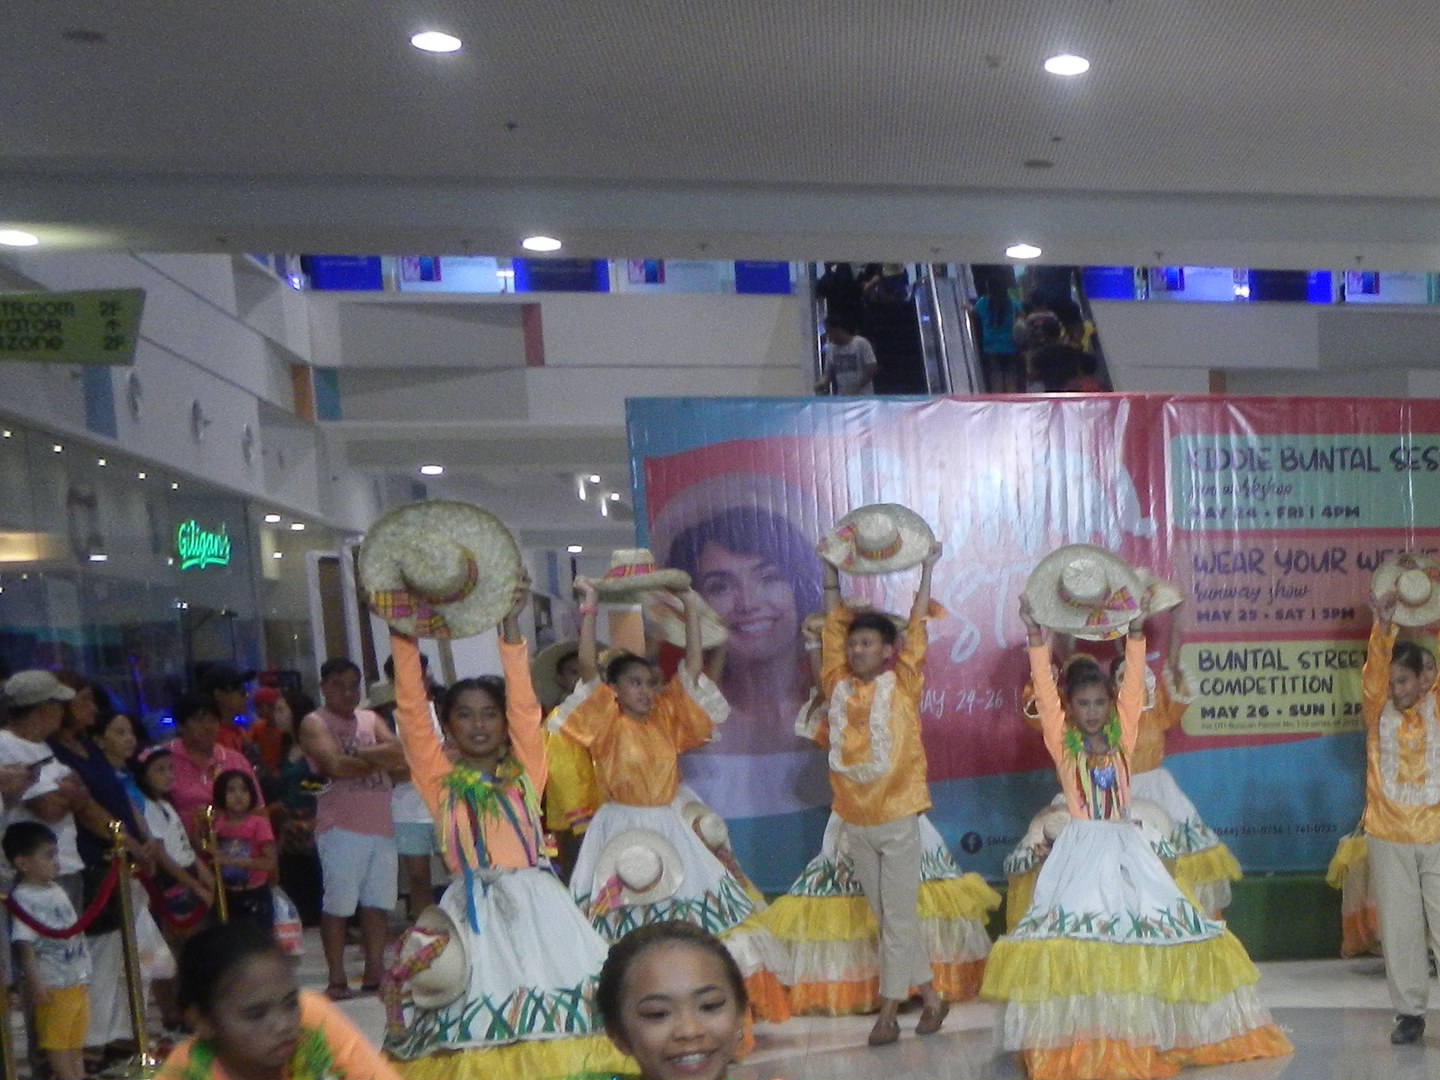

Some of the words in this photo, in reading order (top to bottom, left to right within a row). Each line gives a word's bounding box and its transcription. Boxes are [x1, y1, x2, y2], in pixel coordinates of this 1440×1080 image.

[1280, 447, 1381, 473] BUNTAL
[1321, 506, 1360, 519] 4PM
[1193, 549, 1265, 575] WEAR
[1273, 547, 1348, 575] YOUR
[1268, 579, 1311, 605] show
[1196, 608, 1232, 622] MAY
[1274, 608, 1306, 621] SAT
[1198, 648, 1289, 671] BUNTAL
[1200, 675, 1334, 696] COMPETITION
[1200, 704, 1239, 719] MAY
[1246, 704, 1270, 718] 26
[1289, 702, 1325, 717] SUN
[1343, 702, 1363, 716] 2P
